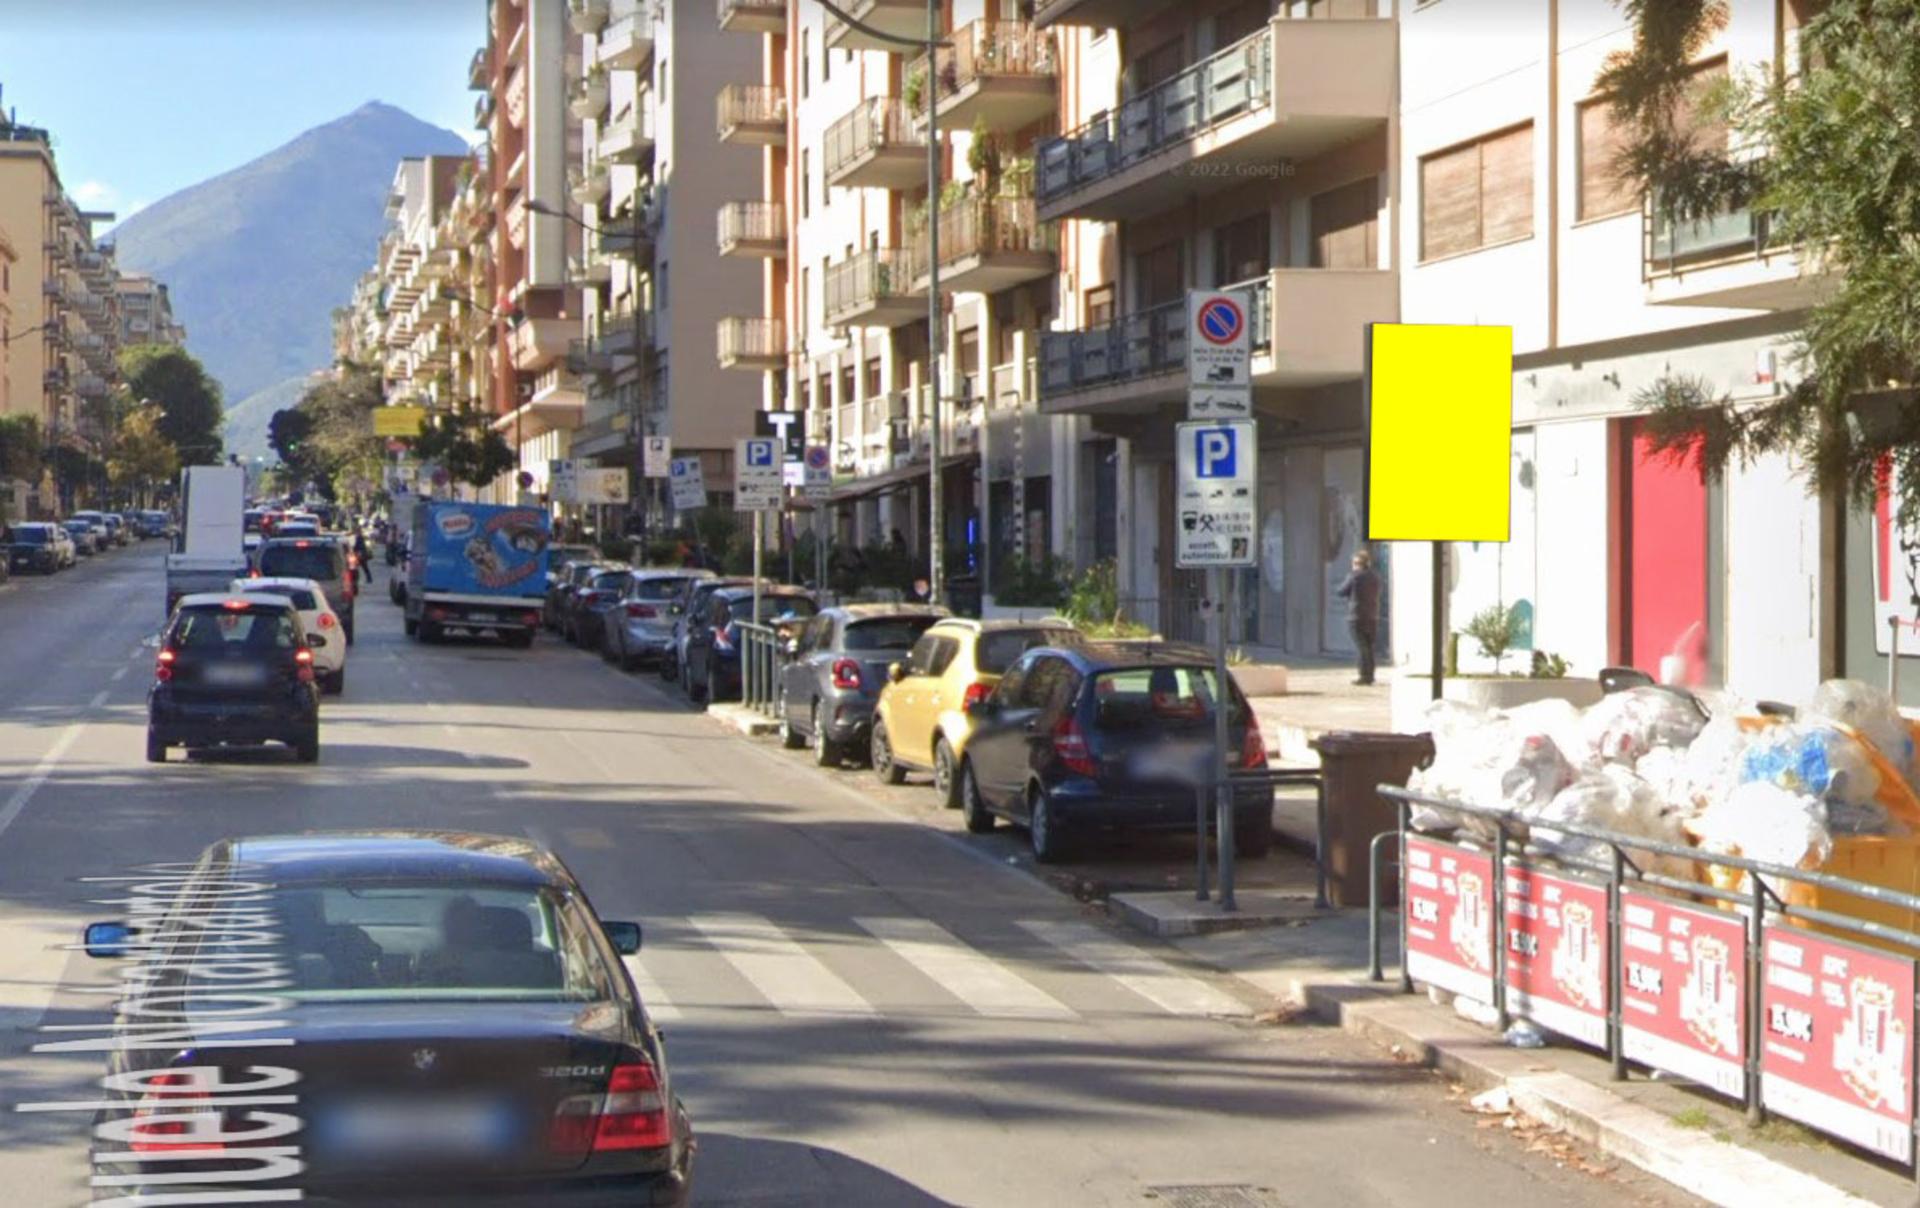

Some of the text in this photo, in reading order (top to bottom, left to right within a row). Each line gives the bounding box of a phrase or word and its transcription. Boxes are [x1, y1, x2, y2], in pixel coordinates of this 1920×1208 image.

[750, 443, 768, 465] P
[1202, 432, 1230, 475] P
[540, 1065, 606, 1077] 320d
